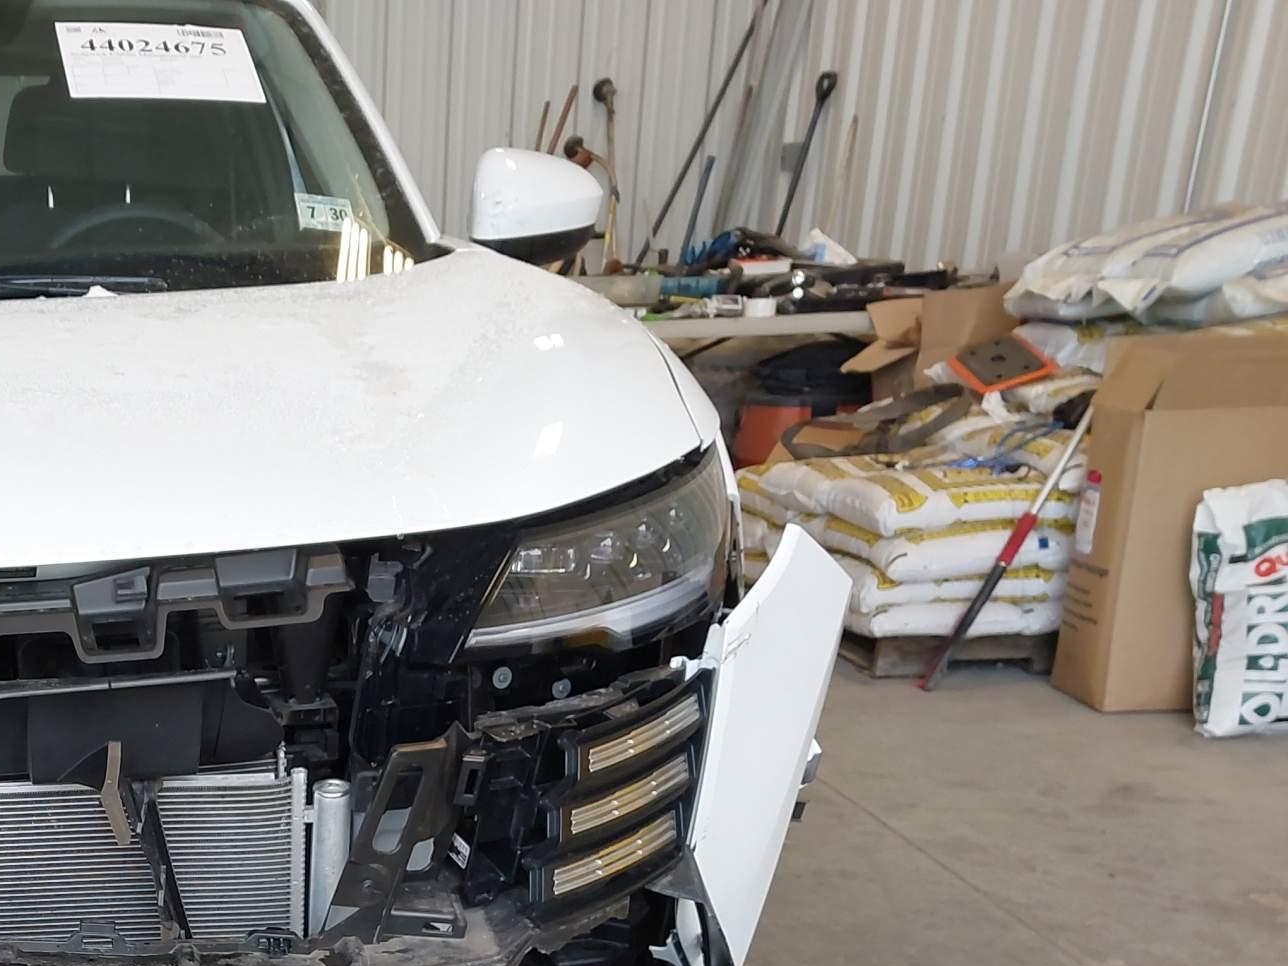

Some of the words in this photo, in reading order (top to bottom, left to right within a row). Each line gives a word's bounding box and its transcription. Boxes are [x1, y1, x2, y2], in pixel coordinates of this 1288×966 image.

[80, 37, 228, 56] 44024675
[306, 206, 316, 219] 7
[329, 207, 348, 221] 30
